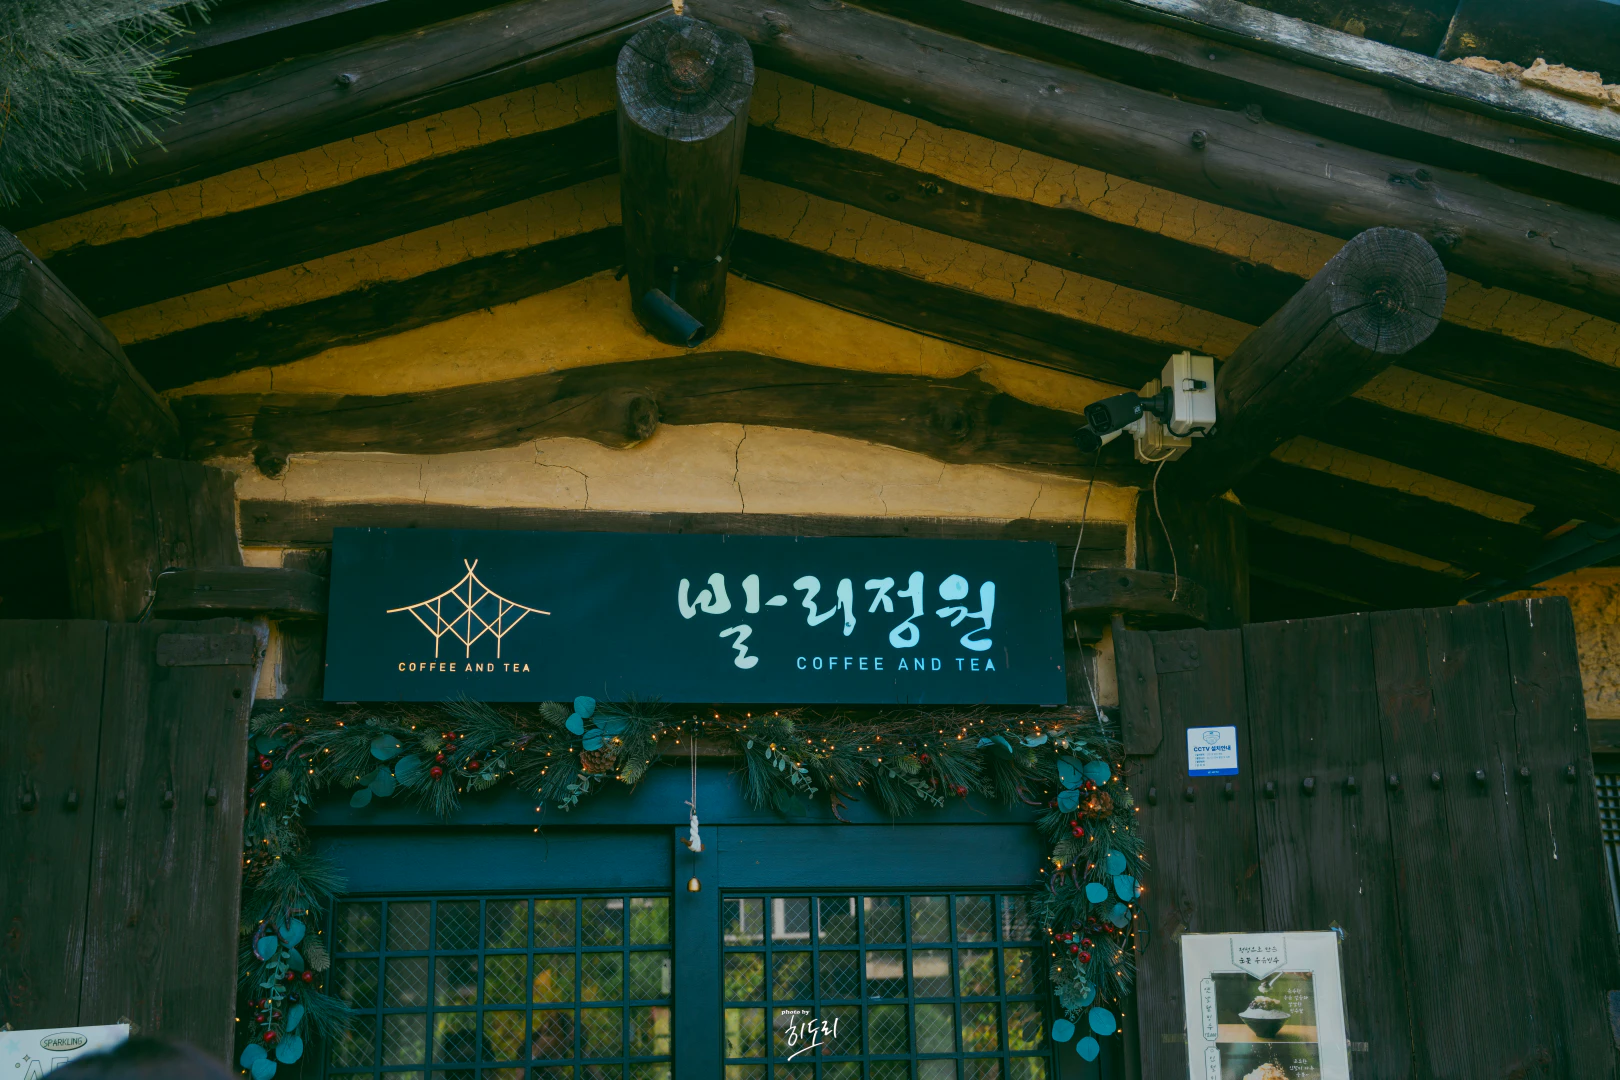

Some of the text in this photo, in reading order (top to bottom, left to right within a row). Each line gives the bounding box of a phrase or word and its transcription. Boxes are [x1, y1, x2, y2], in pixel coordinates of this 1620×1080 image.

[678, 571, 996, 669] 발리정원
[398, 662, 530, 673] COFFEE AND TEA
[796, 656, 996, 672] COFFEE AND TEA
[1255, 956, 1280, 964] 우유빙수
[43, 1037, 83, 1048] SPARKLING
